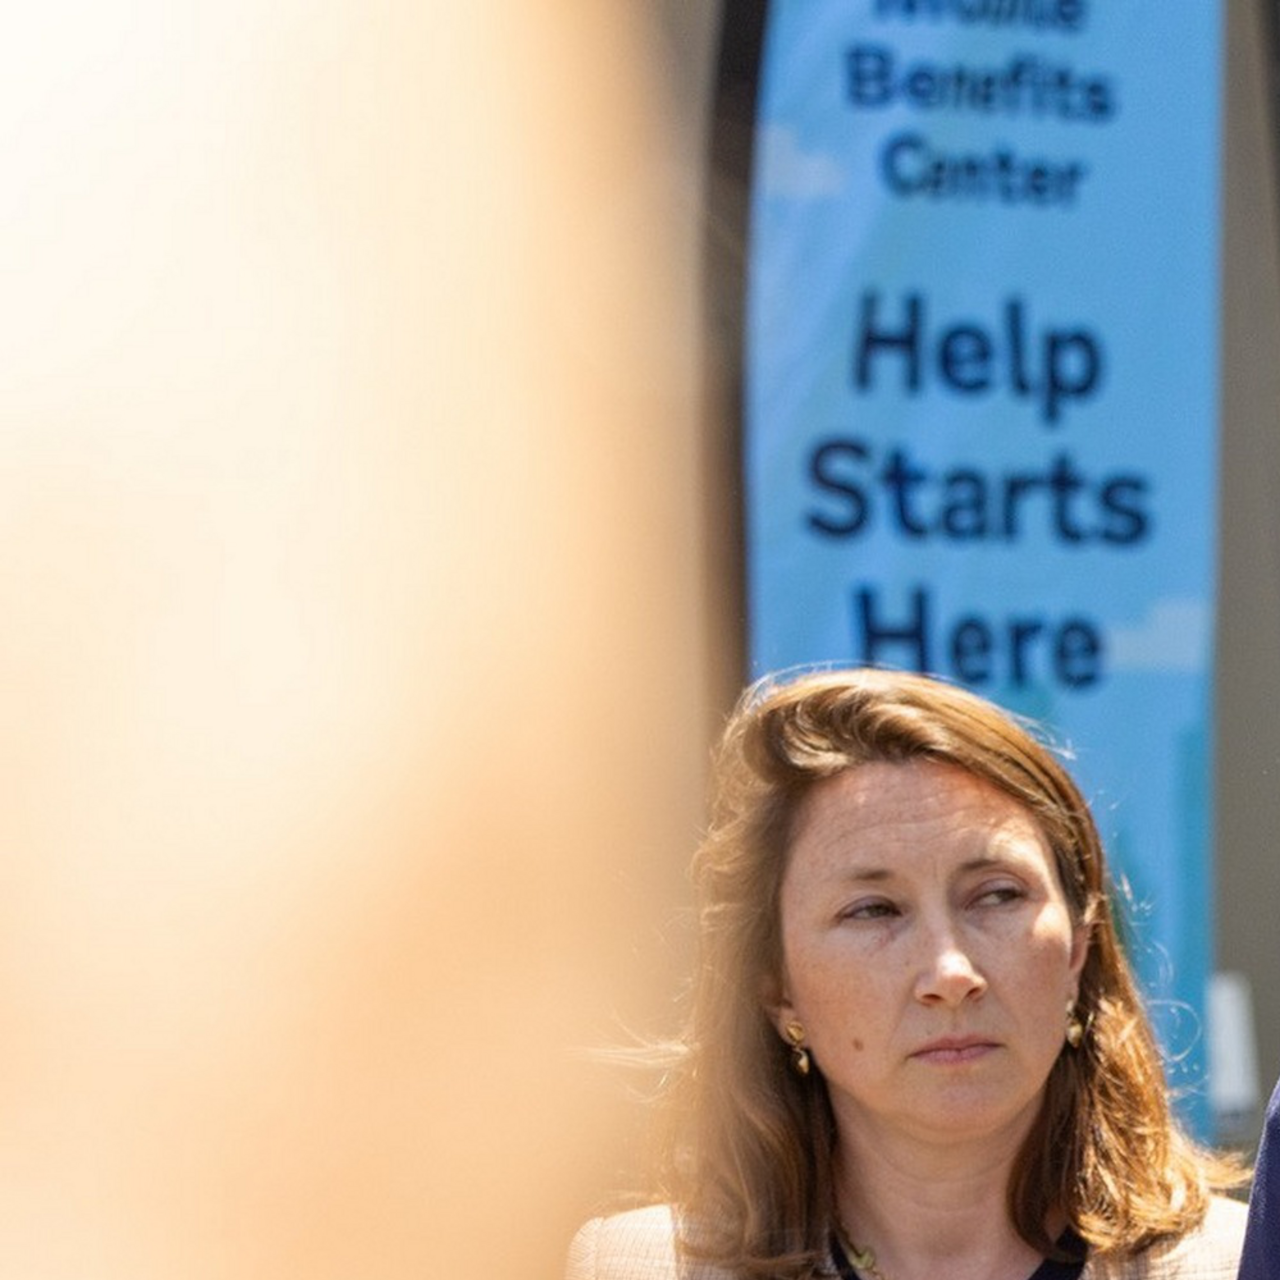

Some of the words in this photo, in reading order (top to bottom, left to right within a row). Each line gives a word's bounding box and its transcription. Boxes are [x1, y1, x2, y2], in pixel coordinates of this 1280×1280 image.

[844, 44, 1116, 124] Benefits
[878, 133, 1090, 206] Center
[852, 292, 1106, 426] Help
[804, 436, 1154, 548] Starts
[854, 581, 1106, 691] Here
